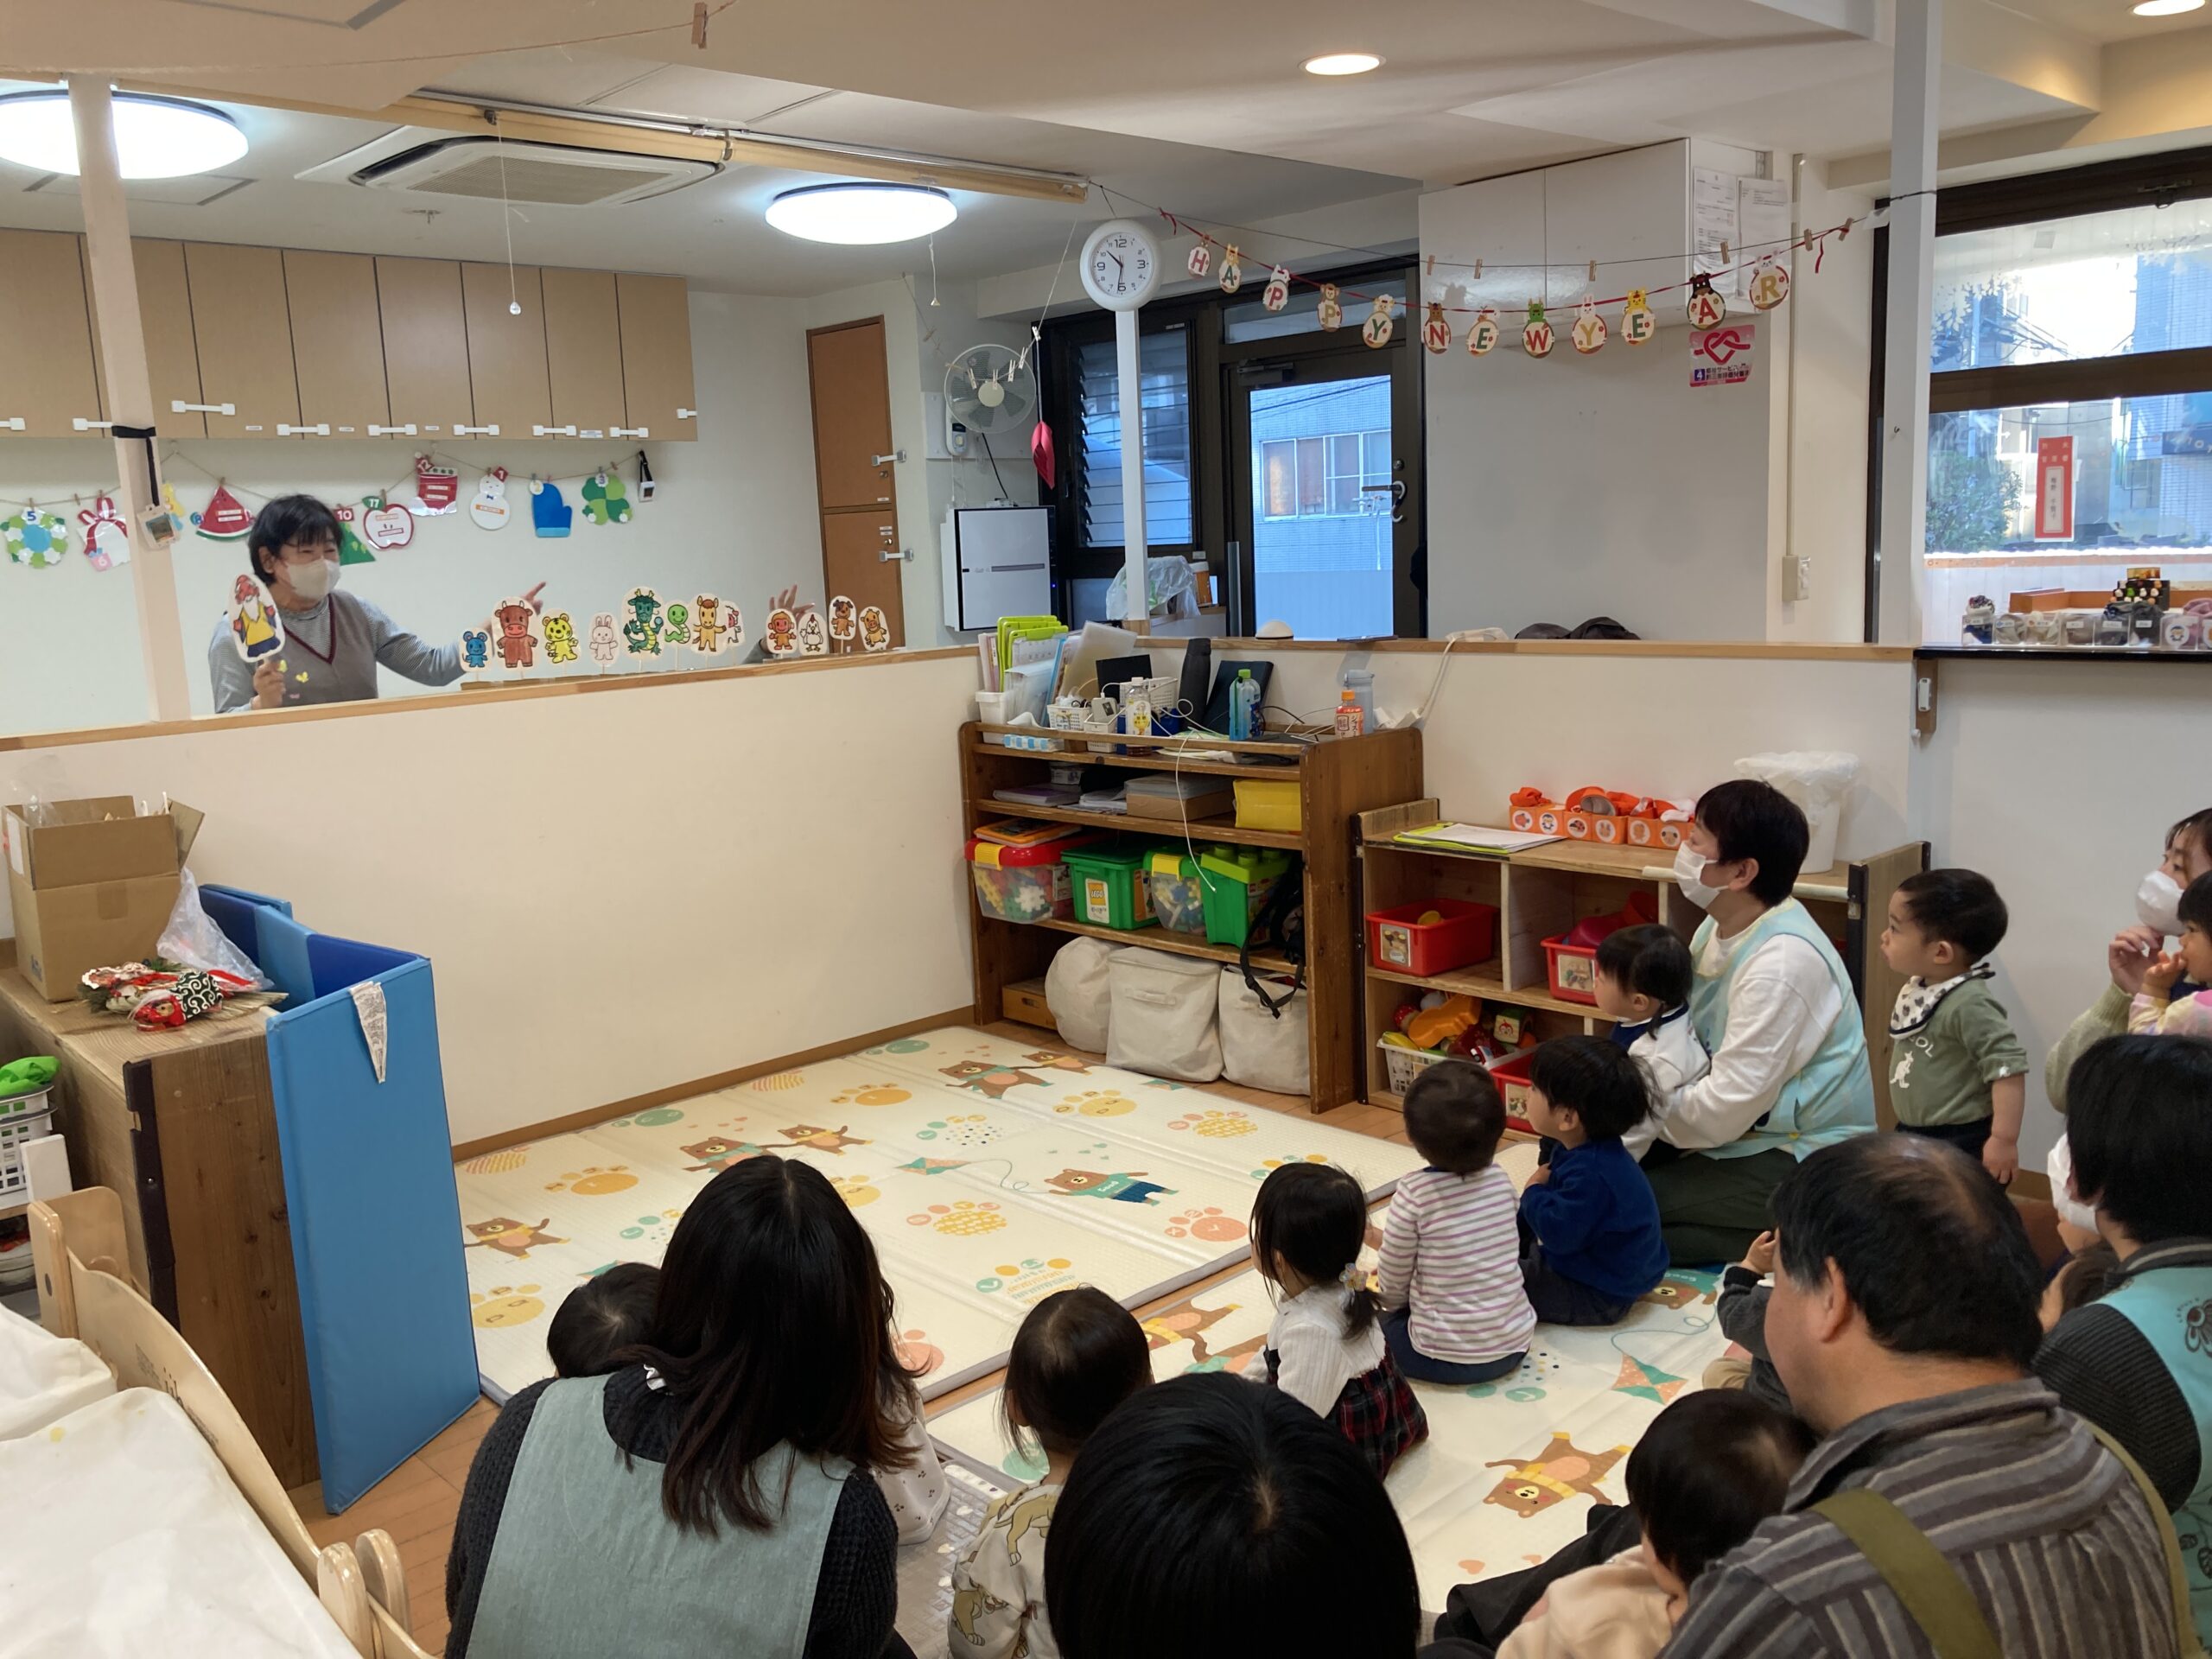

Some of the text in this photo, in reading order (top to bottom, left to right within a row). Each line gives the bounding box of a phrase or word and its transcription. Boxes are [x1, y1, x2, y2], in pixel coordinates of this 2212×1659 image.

[1115, 239, 1127, 248] 12
[1096, 262, 1105, 271] 9
[1137, 259, 1146, 269] 3
[1118, 283, 1127, 292] 6
[1191, 250, 1782, 352] HAPPY NEW YEAR
[1696, 372, 1703, 380] 4
[417, 459, 431, 473] 12
[27, 511, 36, 521] 5
[337, 510, 352, 520] 10
[99, 556, 107, 566] 6
[1090, 889, 1103, 898] LEGO
